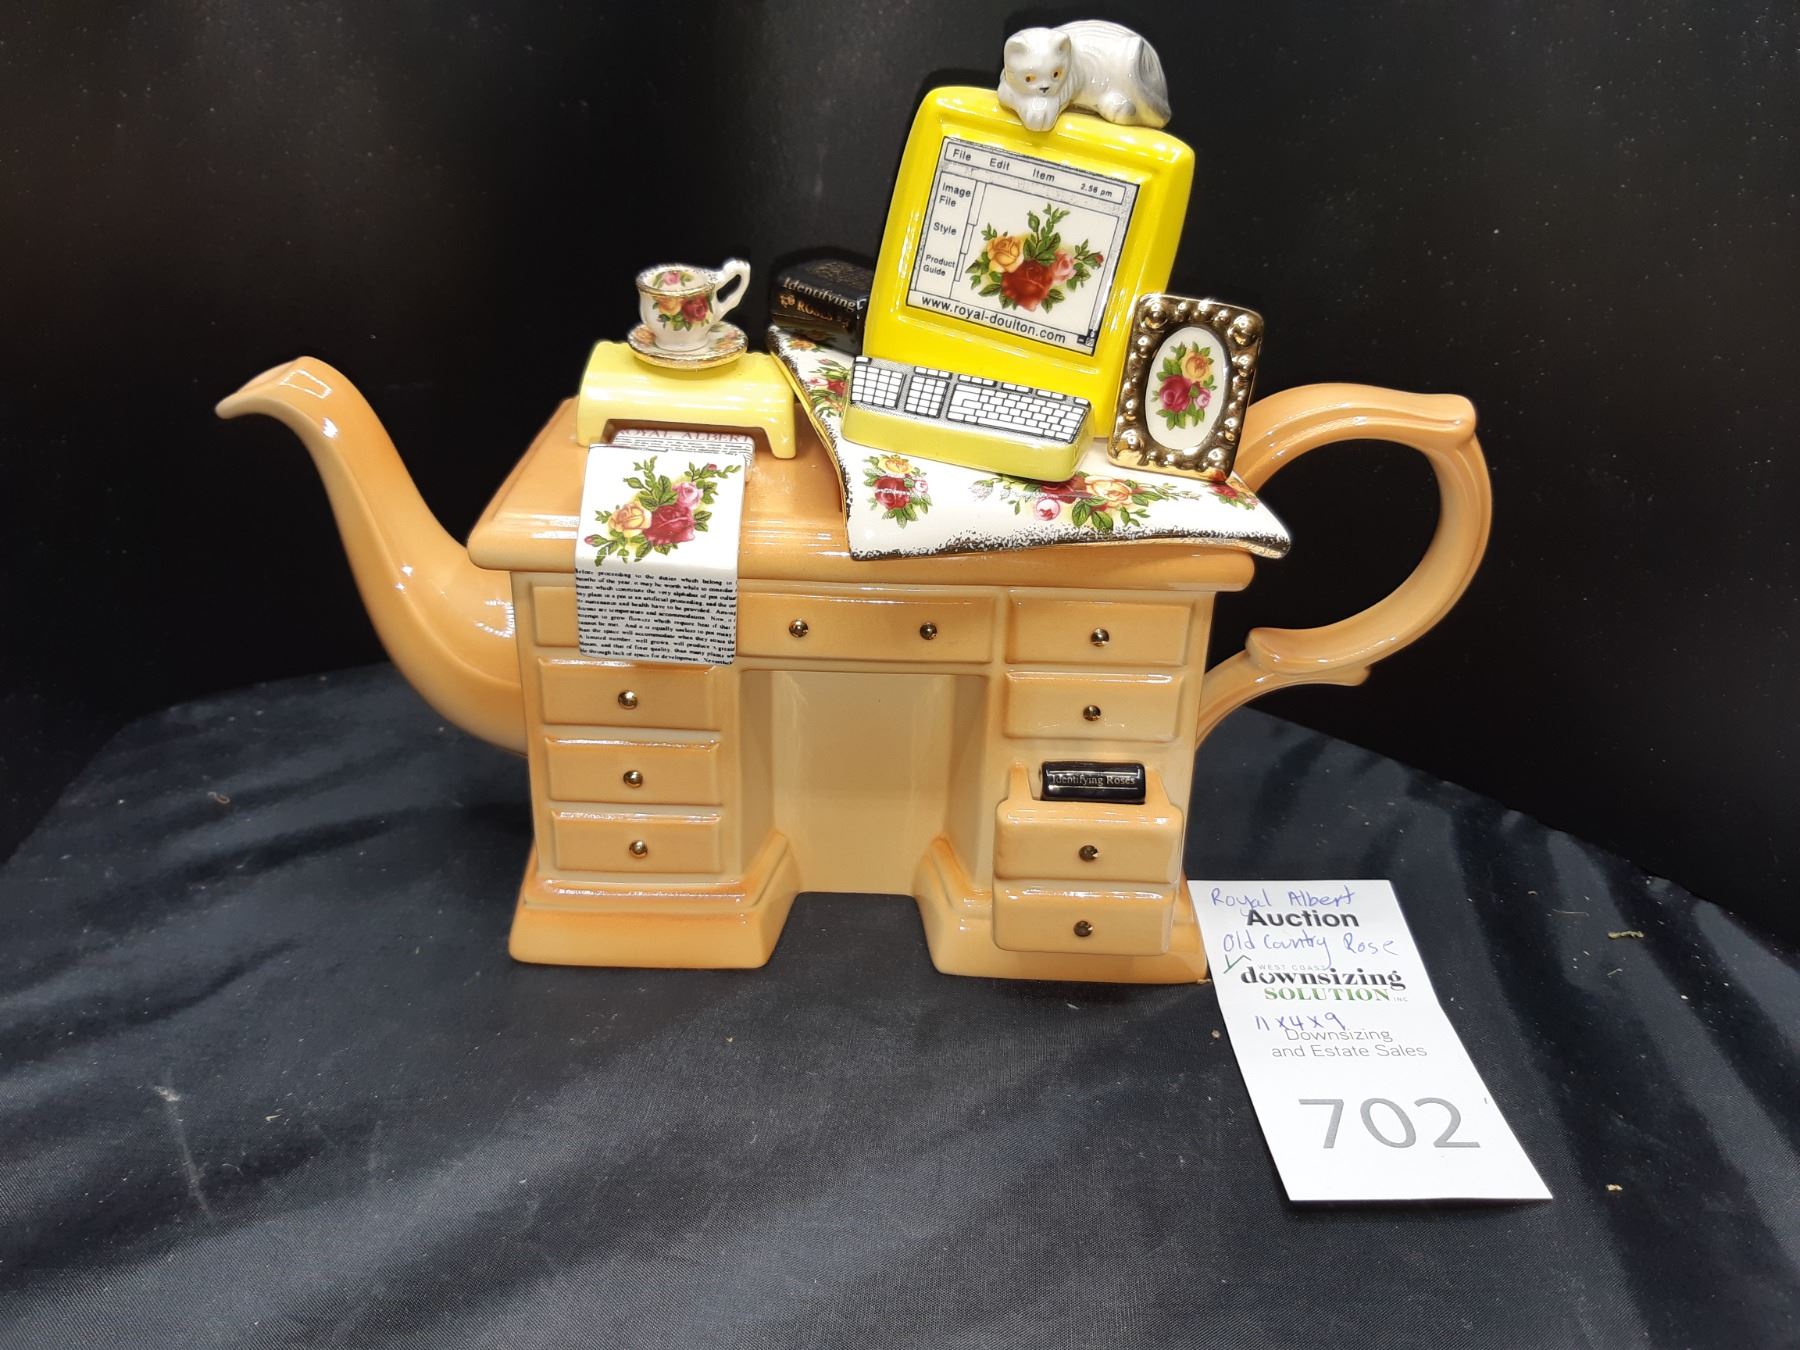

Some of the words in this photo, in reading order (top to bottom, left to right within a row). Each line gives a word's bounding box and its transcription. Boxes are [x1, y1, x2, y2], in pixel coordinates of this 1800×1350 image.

[952, 148, 972, 161] File
[990, 158, 1010, 171] Edit
[1032, 168, 1055, 182] Item
[942, 182, 971, 198] Image
[939, 195, 956, 207] File
[933, 222, 957, 235] Style
[926, 254, 956, 268] Product
[923, 264, 946, 276] Guide
[783, 276, 857, 312] Identifying
[921, 295, 1066, 344] www.royal-doulton.com
[1052, 774, 1104, 786] Identifying
[1106, 775, 1136, 785] Roses
[1210, 888, 1272, 917] Royal
[1288, 884, 1355, 908] Albert
[1246, 909, 1360, 927] Auction
[1223, 930, 1256, 952] Old
[1343, 932, 1399, 956] Rose
[1240, 966, 1406, 991] downsizing
[1264, 987, 1390, 1001] SOLUTION
[1284, 1028, 1393, 1042] Downsizing
[1272, 1044, 1306, 1057] and
[1310, 1044, 1370, 1057] Estate
[1374, 1044, 1428, 1057] Sales
[1298, 1097, 1481, 1149] 702
